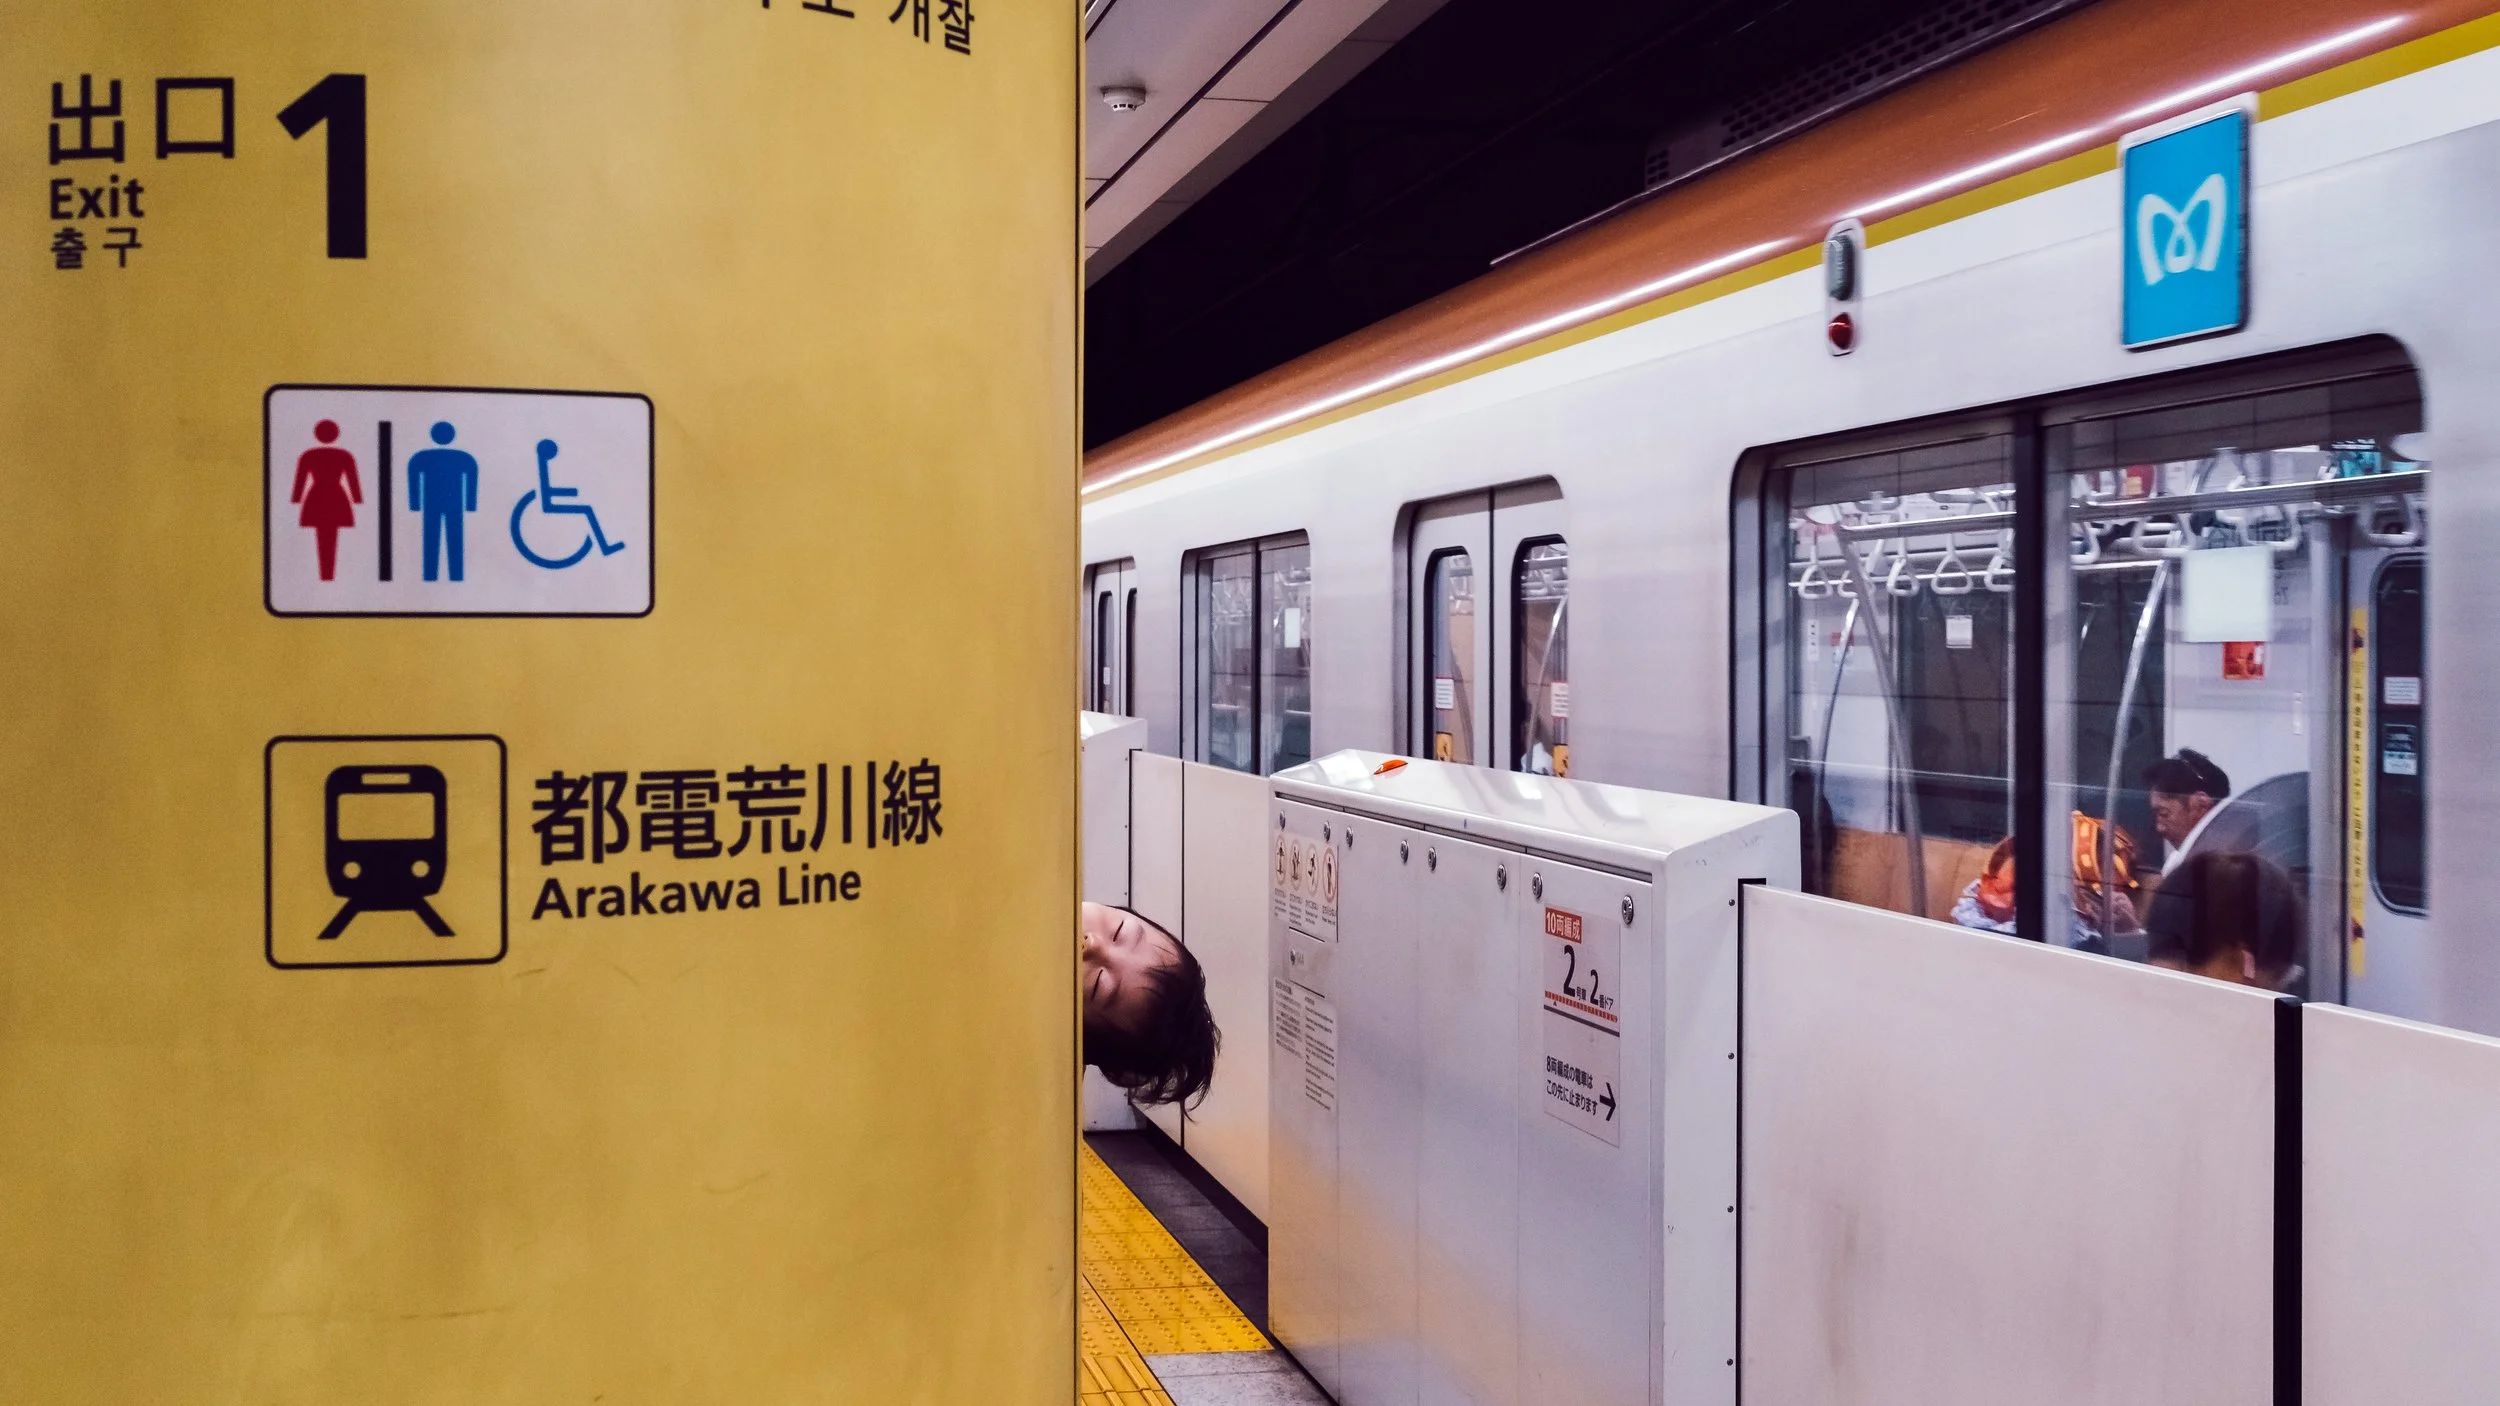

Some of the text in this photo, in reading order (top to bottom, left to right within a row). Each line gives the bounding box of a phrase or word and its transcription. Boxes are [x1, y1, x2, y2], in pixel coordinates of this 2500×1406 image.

[48, 73, 368, 259] 出口 1
[50, 176, 144, 220] Exit
[51, 227, 143, 269] 출구
[531, 757, 945, 866] 都電荒川線
[531, 862, 862, 921] Arakawa Line
[1546, 1079, 1598, 1116] この先に止まります
